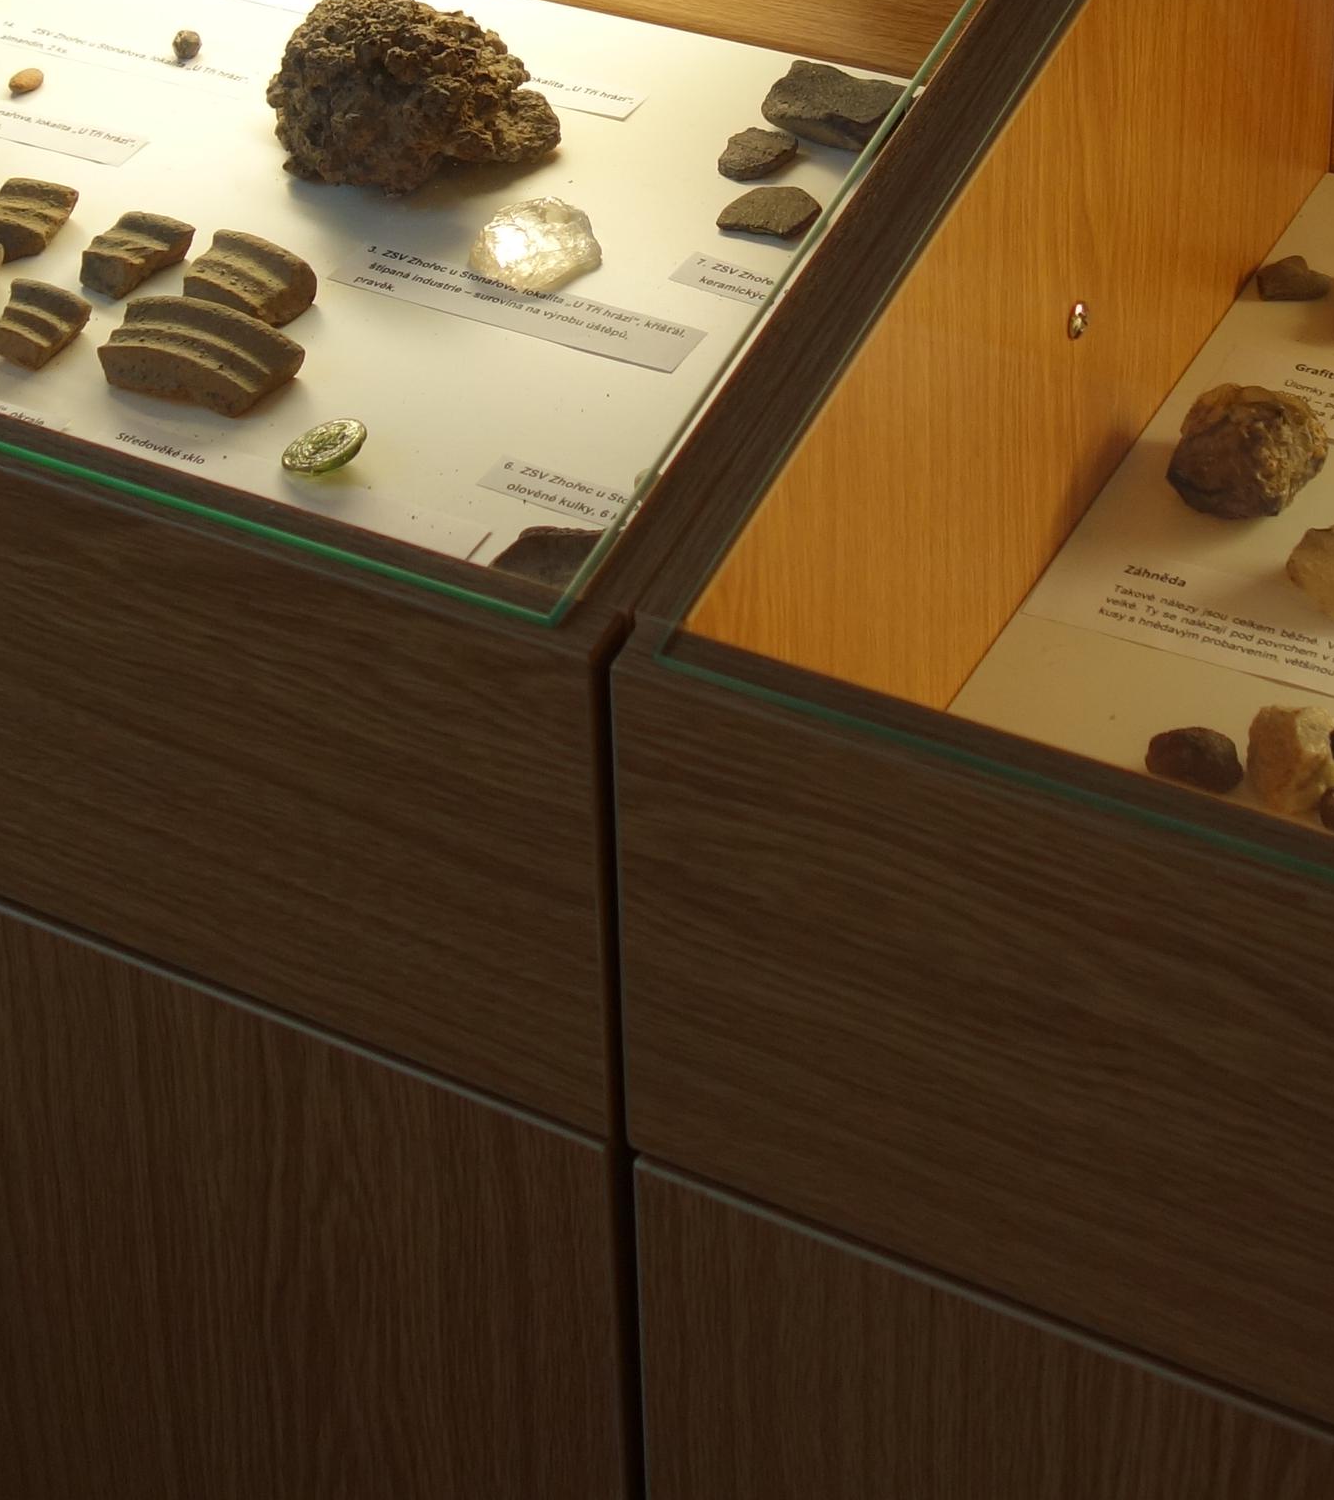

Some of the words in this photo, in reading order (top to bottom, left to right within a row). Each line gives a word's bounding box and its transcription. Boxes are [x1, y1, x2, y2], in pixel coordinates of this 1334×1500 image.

[367, 245, 377, 254] 3.
[381, 249, 409, 262] ZSV
[406, 256, 448, 273] Zhořec
[448, 268, 459, 276] u
[522, 287, 565, 305] lokalita
[696, 258, 707, 267] 7.
[711, 262, 740, 275] ZSV
[738, 270, 774, 286] Zhoře
[698, 275, 767, 301] keramickýc
[115, 432, 181, 458] Středověké
[180, 452, 206, 465] sklo
[503, 461, 514, 471] 6.
[519, 466, 550, 480] ZSV
[548, 475, 595, 495] Zhořec
[595, 490, 606, 498] u
[506, 482, 558, 503] olověné
[558, 496, 596, 517] kulky,
[599, 508, 609, 518] 6
[1123, 563, 1187, 589] Záhněda
[1113, 583, 1156, 602] Takové
[1159, 595, 1200, 615] nálezy
[1200, 607, 1229, 622] jsou
[1231, 616, 1276, 635] celkem
